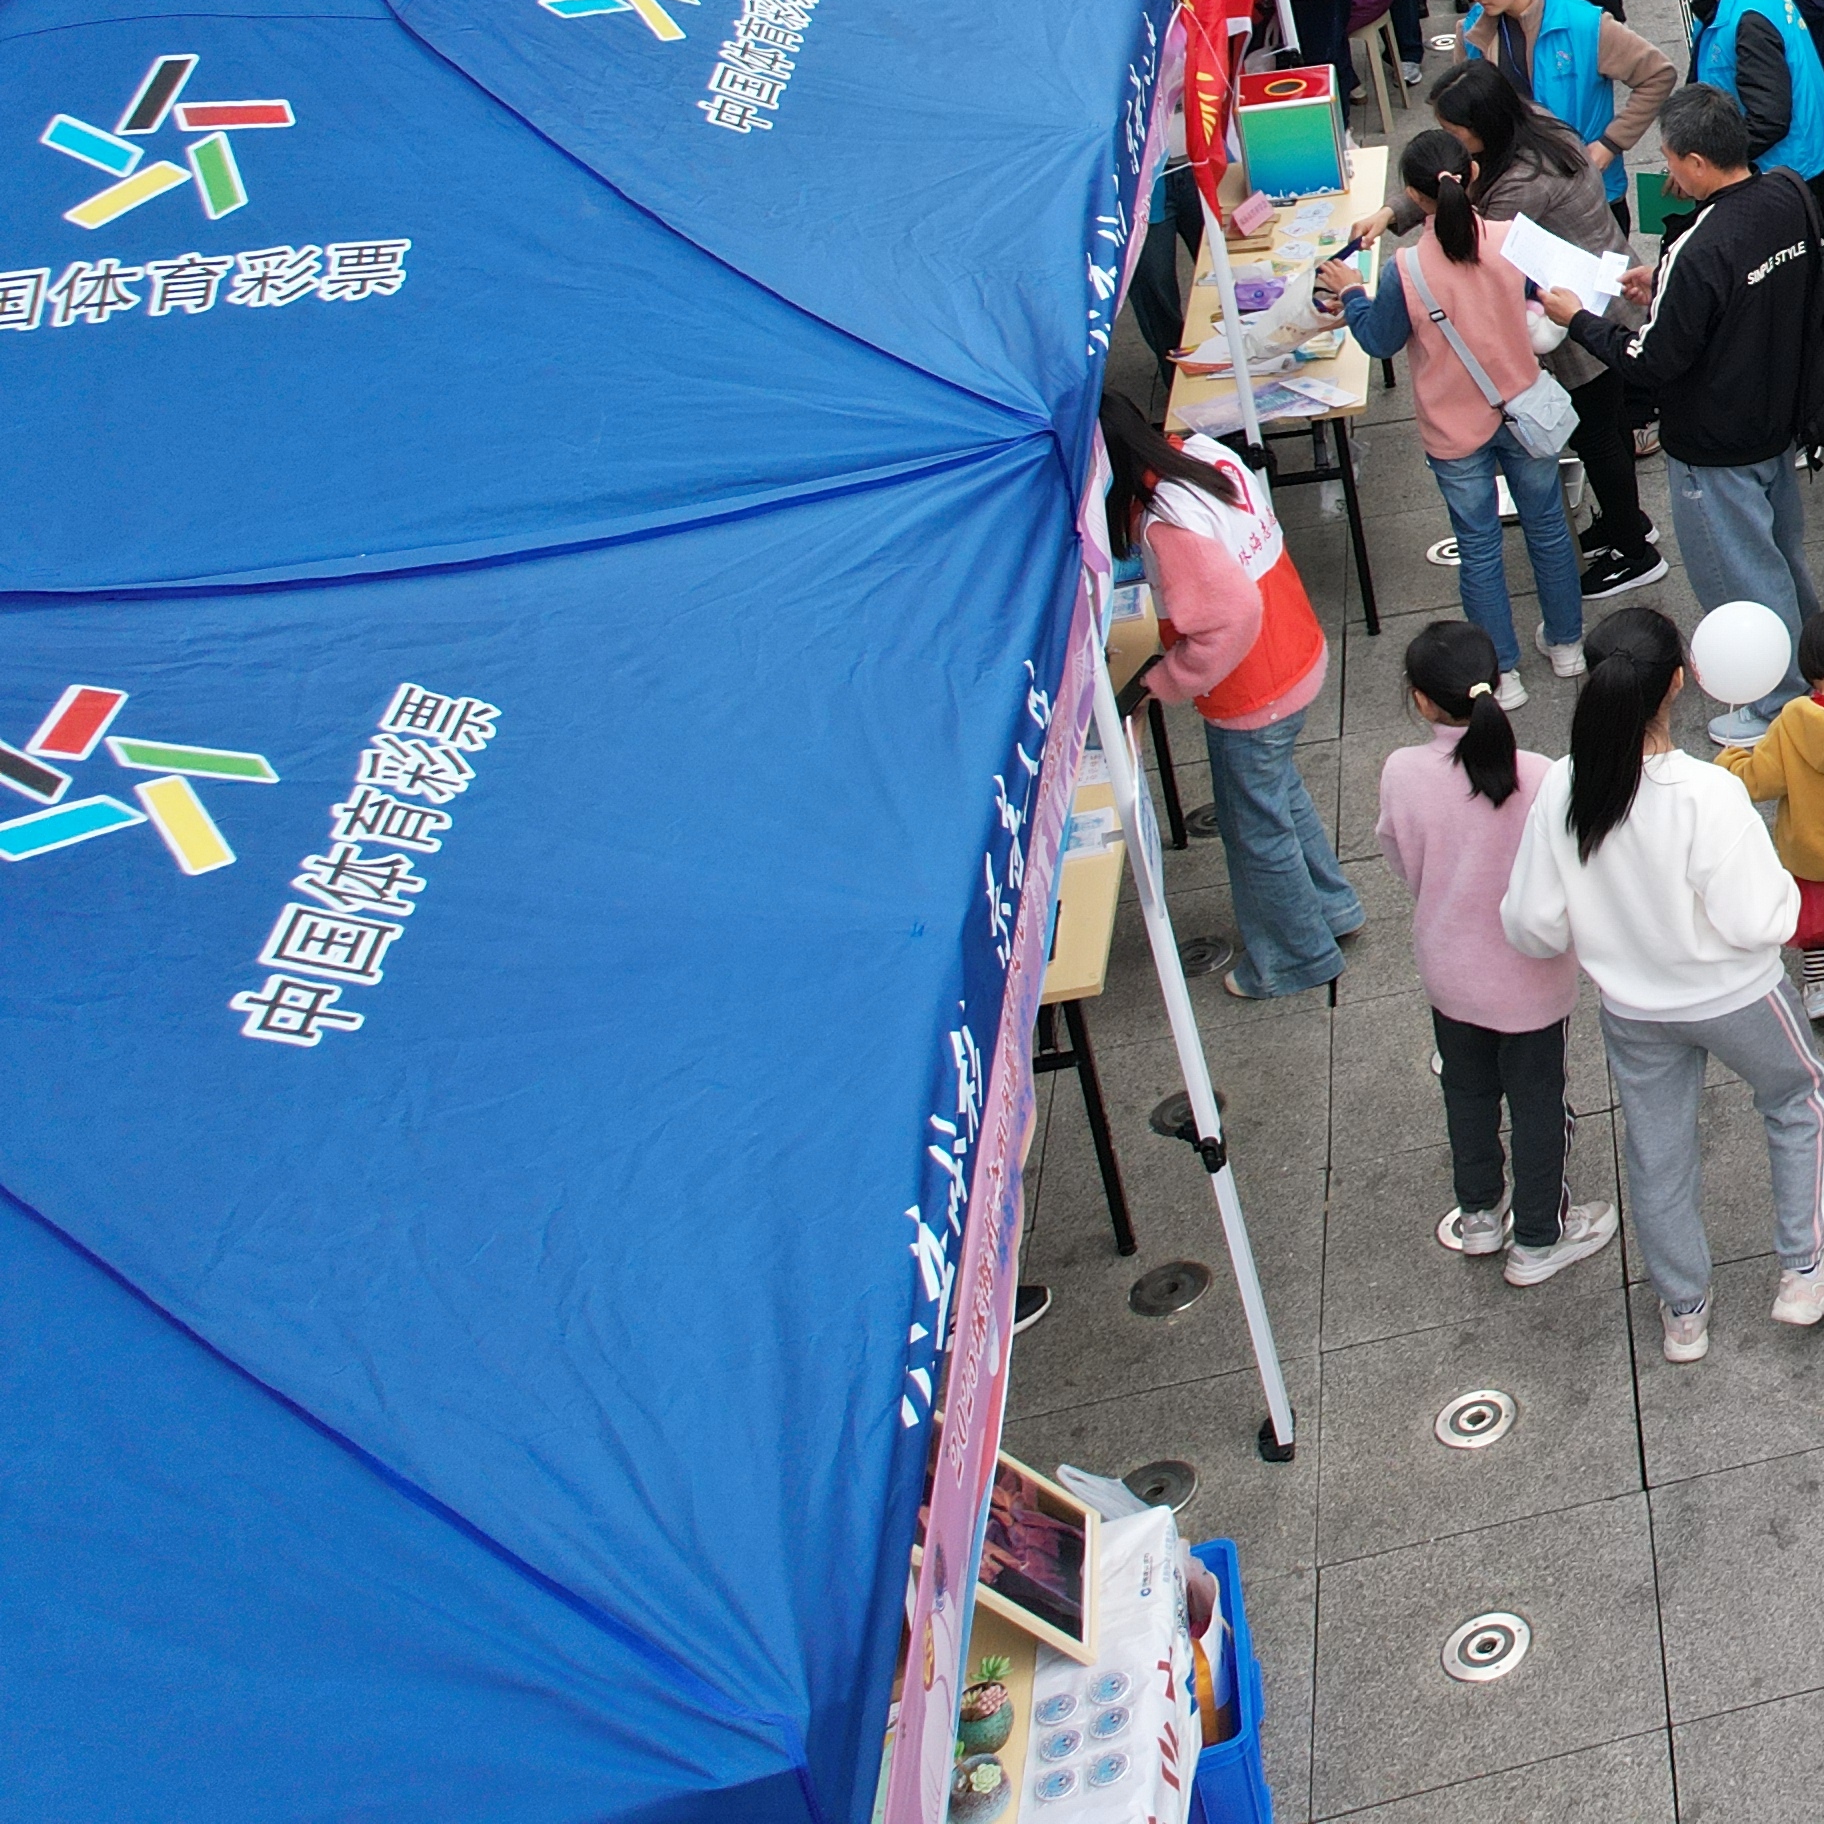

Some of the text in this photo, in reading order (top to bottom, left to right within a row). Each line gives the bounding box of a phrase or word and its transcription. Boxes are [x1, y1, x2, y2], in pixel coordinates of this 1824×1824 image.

[1774, 240, 1808, 269] STYLE
[230, 681, 504, 1048] 中国体育彩票
